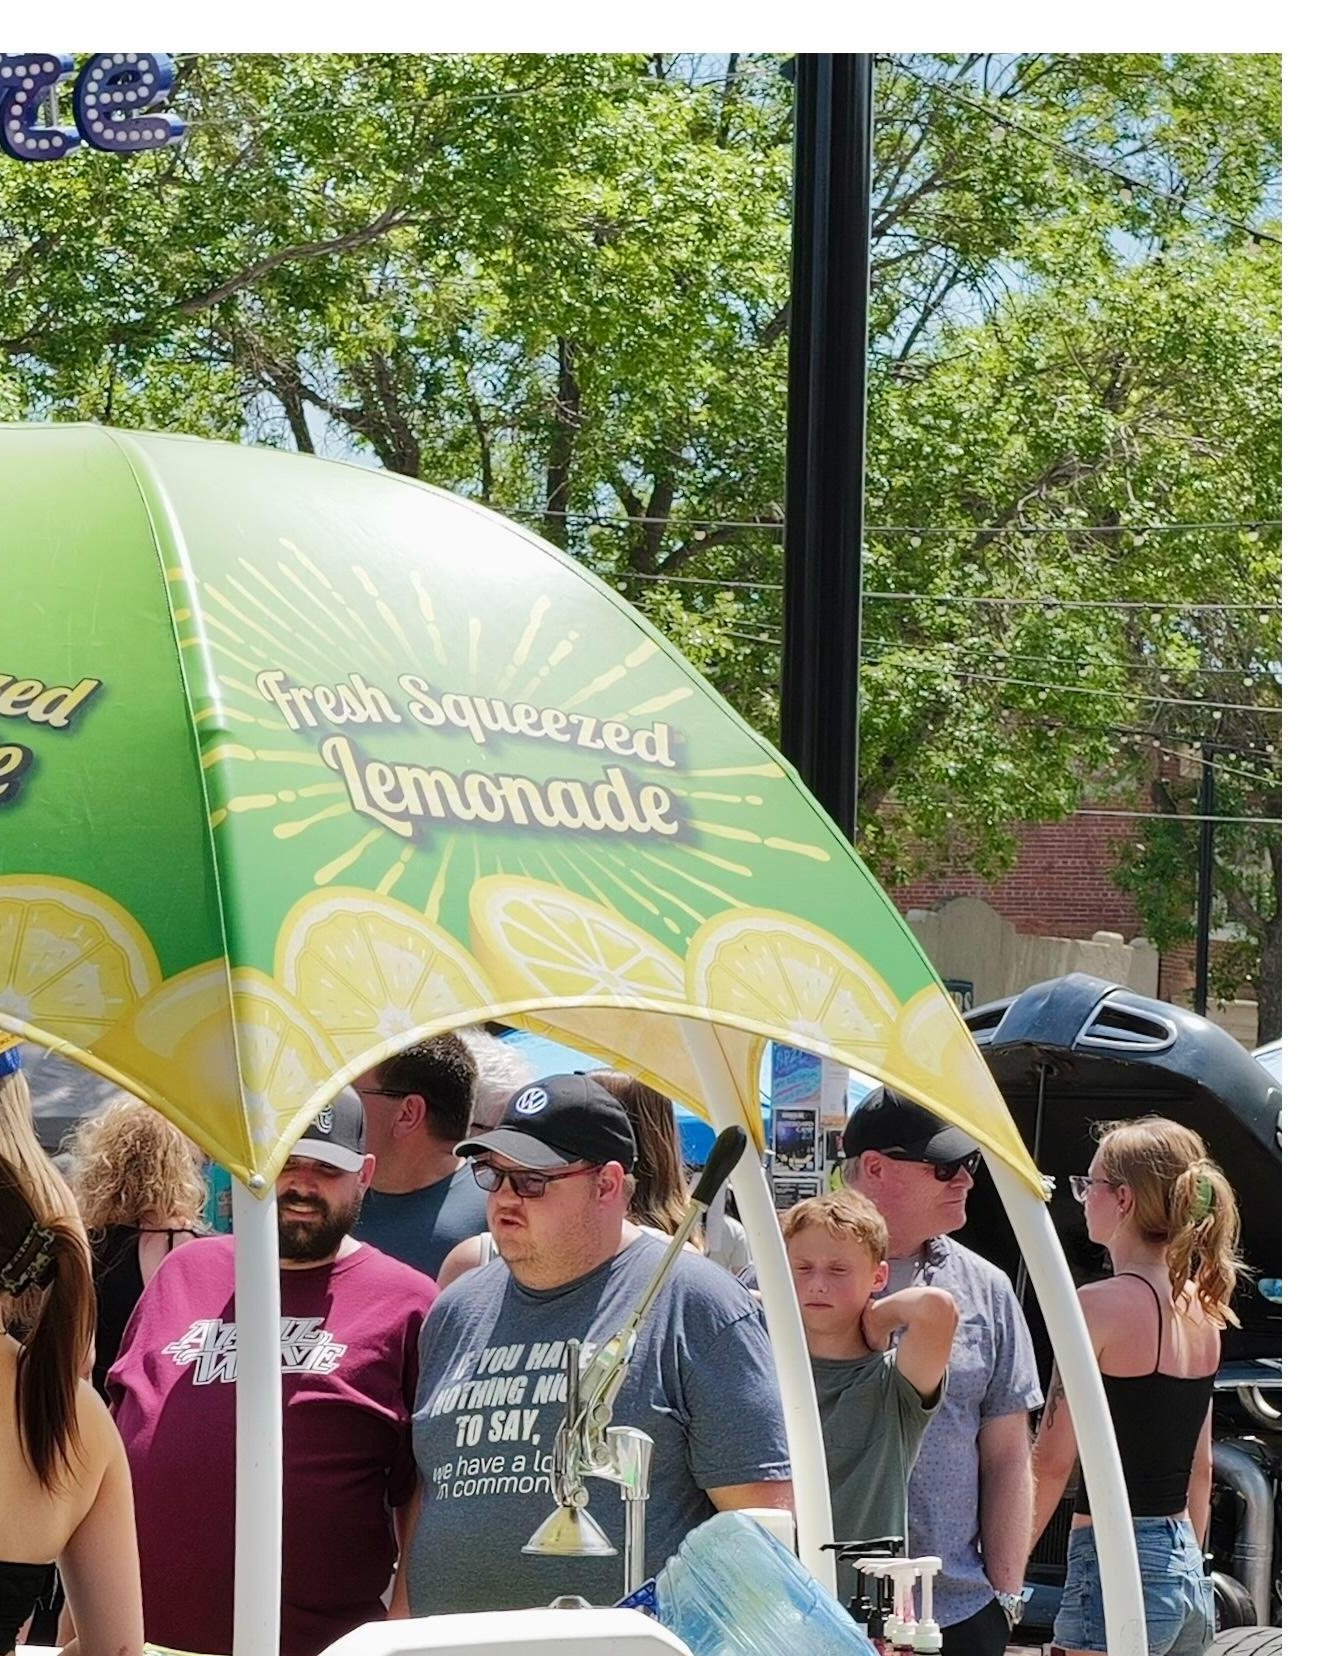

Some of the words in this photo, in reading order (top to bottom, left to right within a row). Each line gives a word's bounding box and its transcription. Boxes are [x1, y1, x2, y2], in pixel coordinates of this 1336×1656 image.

[256, 668, 402, 733] Fresh
[395, 671, 678, 769] Squeezed
[320, 734, 681, 840] Lemonade
[454, 1352, 476, 1380] IF
[477, 1344, 525, 1375] YOU
[525, 1341, 597, 1372] HAE
[430, 1375, 529, 1419] NOTHING
[455, 1414, 485, 1448] TO
[488, 1408, 542, 1447] SAY,
[433, 1462, 453, 1483] we
[456, 1456, 505, 1477] have
[511, 1455, 526, 1473] a
[533, 1450, 553, 1474] lo
[436, 1477, 449, 1501] in
